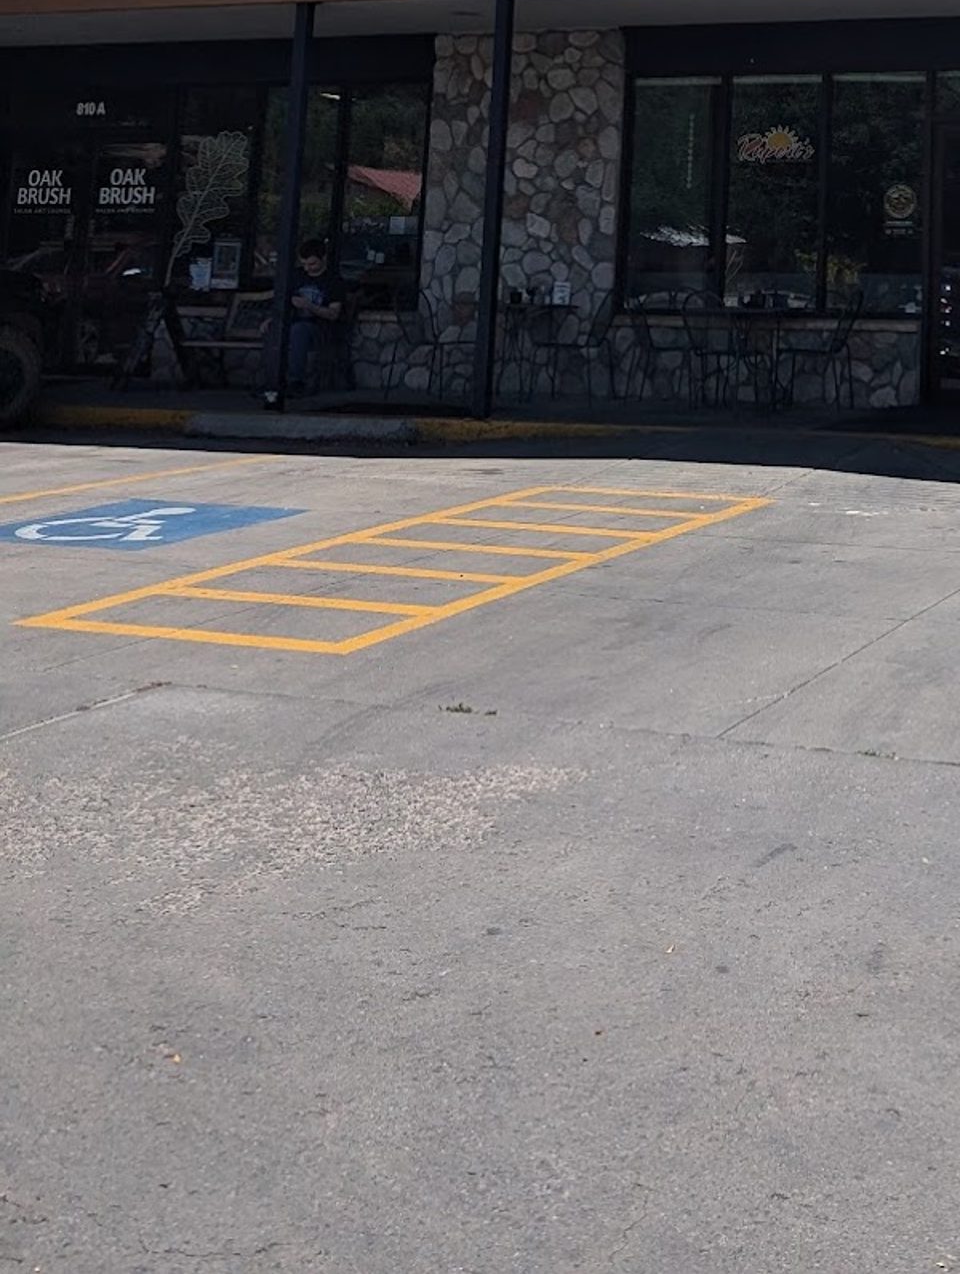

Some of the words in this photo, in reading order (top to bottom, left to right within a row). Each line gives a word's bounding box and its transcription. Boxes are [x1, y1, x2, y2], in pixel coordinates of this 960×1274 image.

[76, 102, 96, 116] 810
[96, 101, 106, 115] A
[28, 169, 63, 187] OAK
[110, 168, 147, 186] OAK
[17, 187, 72, 205] BRUSH
[98, 186, 156, 205] BRUSH
